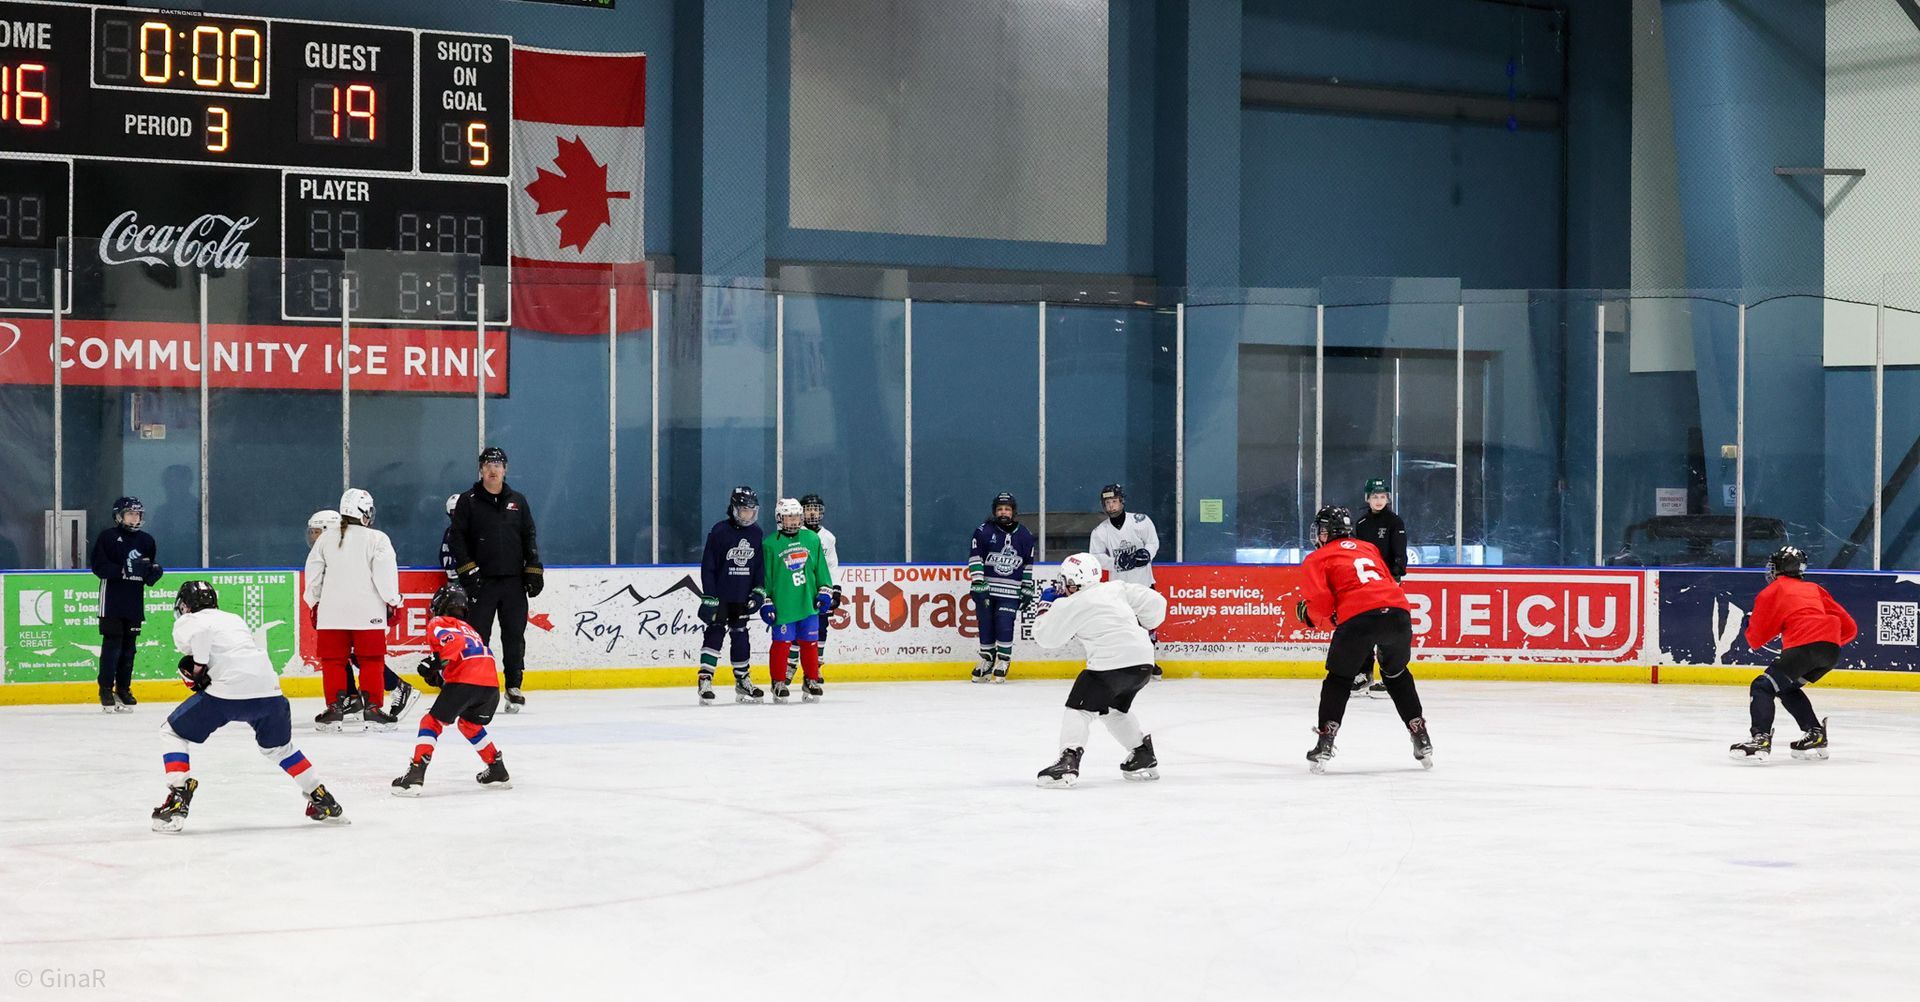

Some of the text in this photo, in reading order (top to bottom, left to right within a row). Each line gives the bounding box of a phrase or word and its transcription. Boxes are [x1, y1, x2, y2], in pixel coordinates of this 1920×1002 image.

[160, 9, 202, 17] DAKTRONICS
[140, 22, 260, 89] 0:00
[304, 41, 381, 72] GUEST
[437, 40, 493, 64] SHOTS
[453, 66, 477, 87] ON
[333, 83, 376, 142] 19
[442, 90, 487, 112] GOAL
[124, 113, 193, 138] PERIOD
[205, 106, 230, 152] 3
[467, 122, 490, 167] 5
[300, 178, 370, 202] PLAYER
[98, 210, 260, 270] Coca-Cola
[49, 336, 497, 378] COMMUNITY ICE RINK
[212, 575, 286, 585] FINISH LINE
[1353, 557, 1382, 584] 6
[63, 589, 73, 600] If
[1169, 585, 1264, 601] Local service,
[64, 603, 76, 612] to
[1169, 602, 1286, 618] always available.
[1404, 592, 1617, 639] BECU
[64, 618, 81, 626] we
[574, 610, 624, 653] Roy
[19, 631, 53, 639] KELLEY
[19, 639, 53, 648] CREATE
